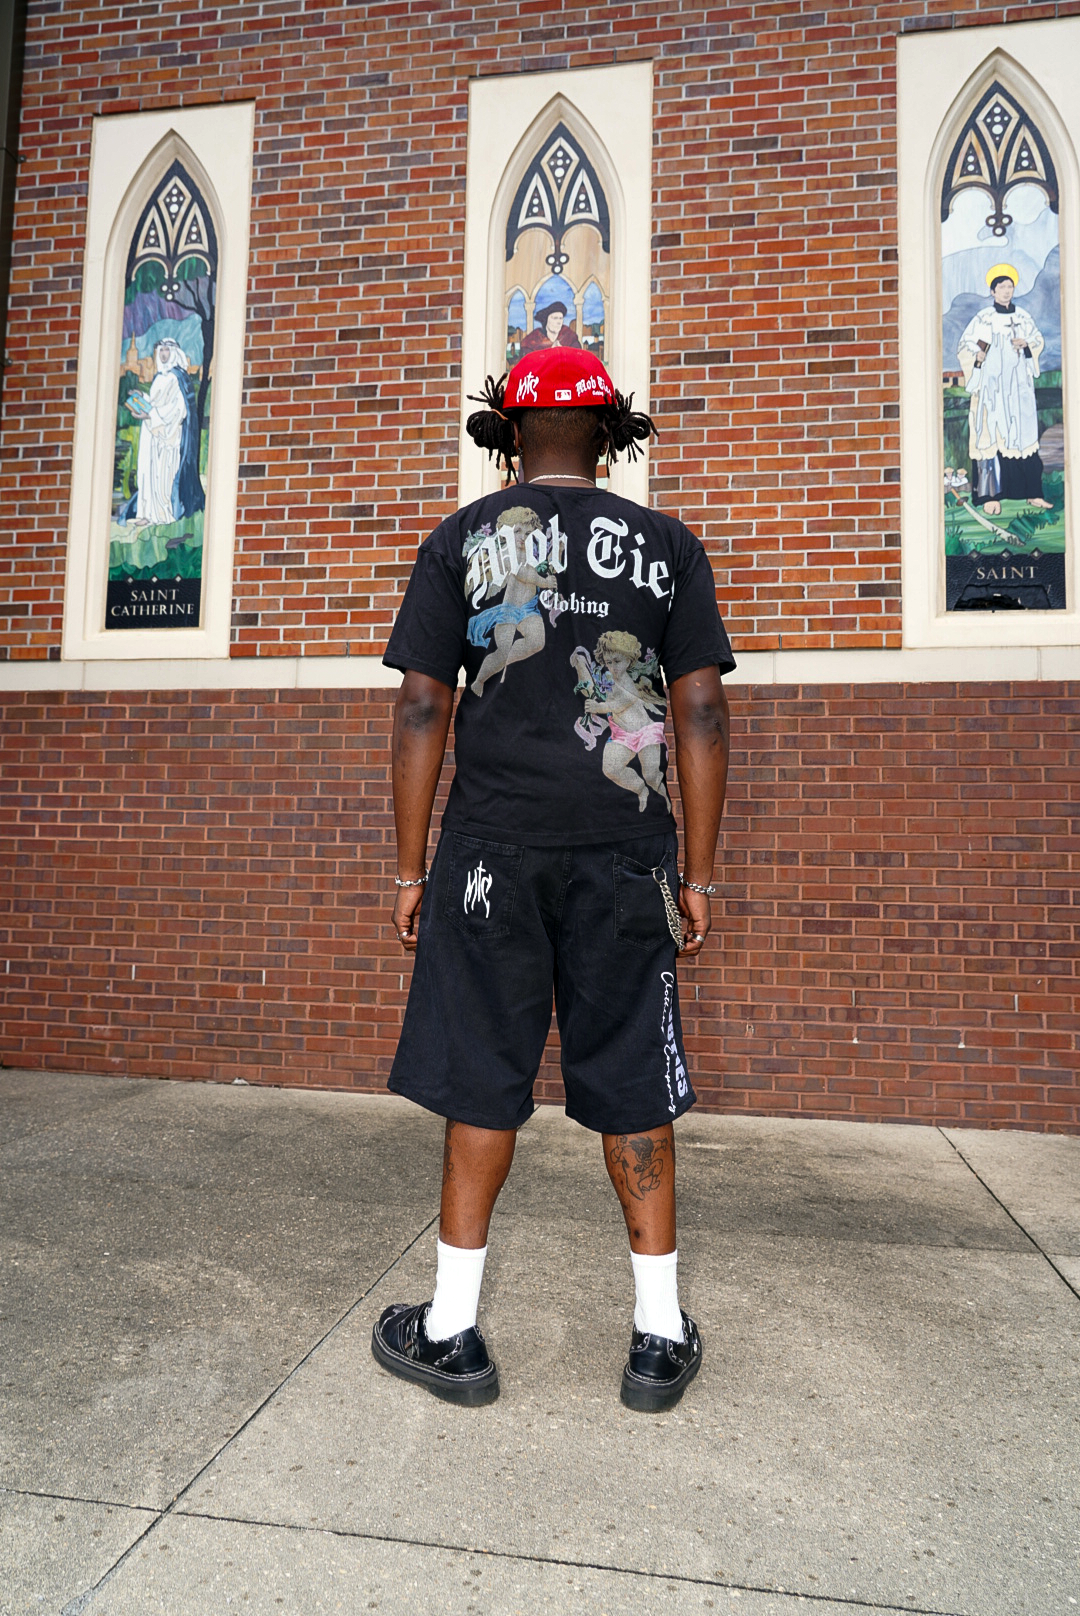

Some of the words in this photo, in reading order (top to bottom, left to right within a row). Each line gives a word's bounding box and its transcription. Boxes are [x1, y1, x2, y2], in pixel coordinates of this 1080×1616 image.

[575, 375, 597, 397] Mob
[466, 513, 568, 610] Mob
[587, 516, 675, 612] Tie
[975, 566, 1039, 580] SAINT
[130, 588, 180, 602] SAINT
[110, 603, 195, 617] CATHERINE
